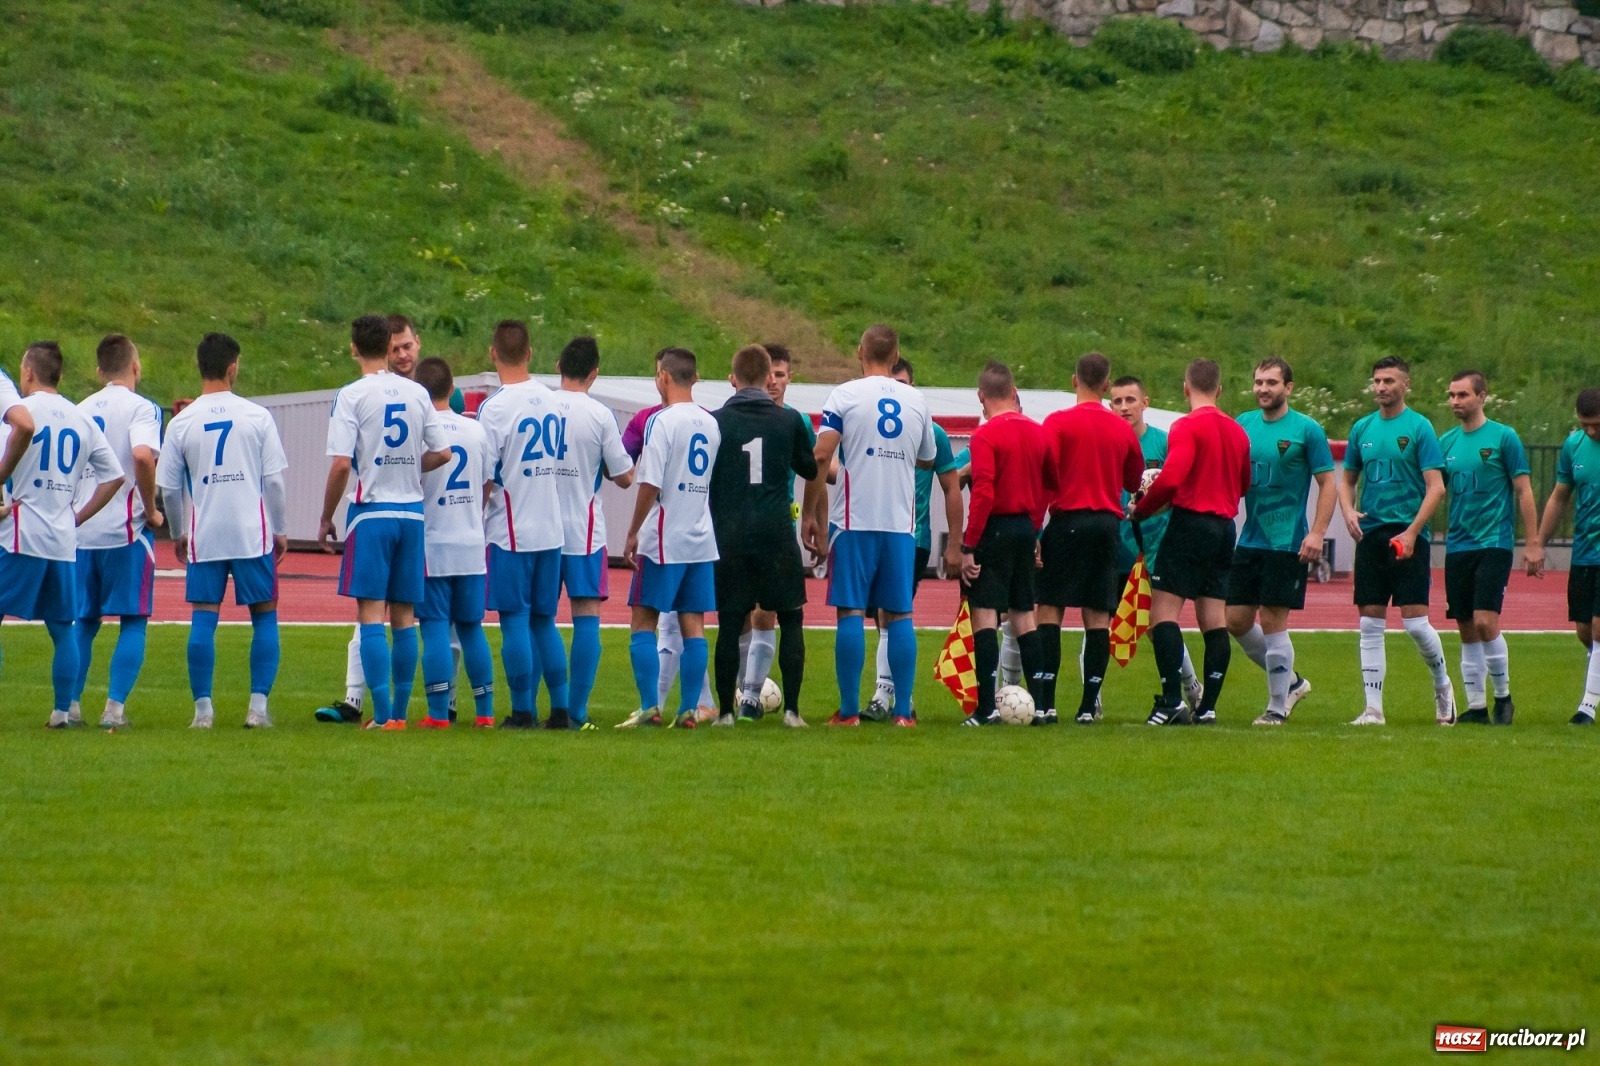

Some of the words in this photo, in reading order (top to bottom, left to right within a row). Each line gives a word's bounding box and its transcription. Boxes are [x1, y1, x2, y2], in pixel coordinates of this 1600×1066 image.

[383, 403, 409, 448] 5
[517, 413, 560, 462] 20
[877, 397, 903, 439] 8
[32, 425, 81, 475] 10
[203, 420, 234, 466] 7
[688, 432, 709, 476] 6
[741, 437, 763, 484] 1
[211, 470, 245, 484] Rozruch
[445, 445, 470, 491] 2
